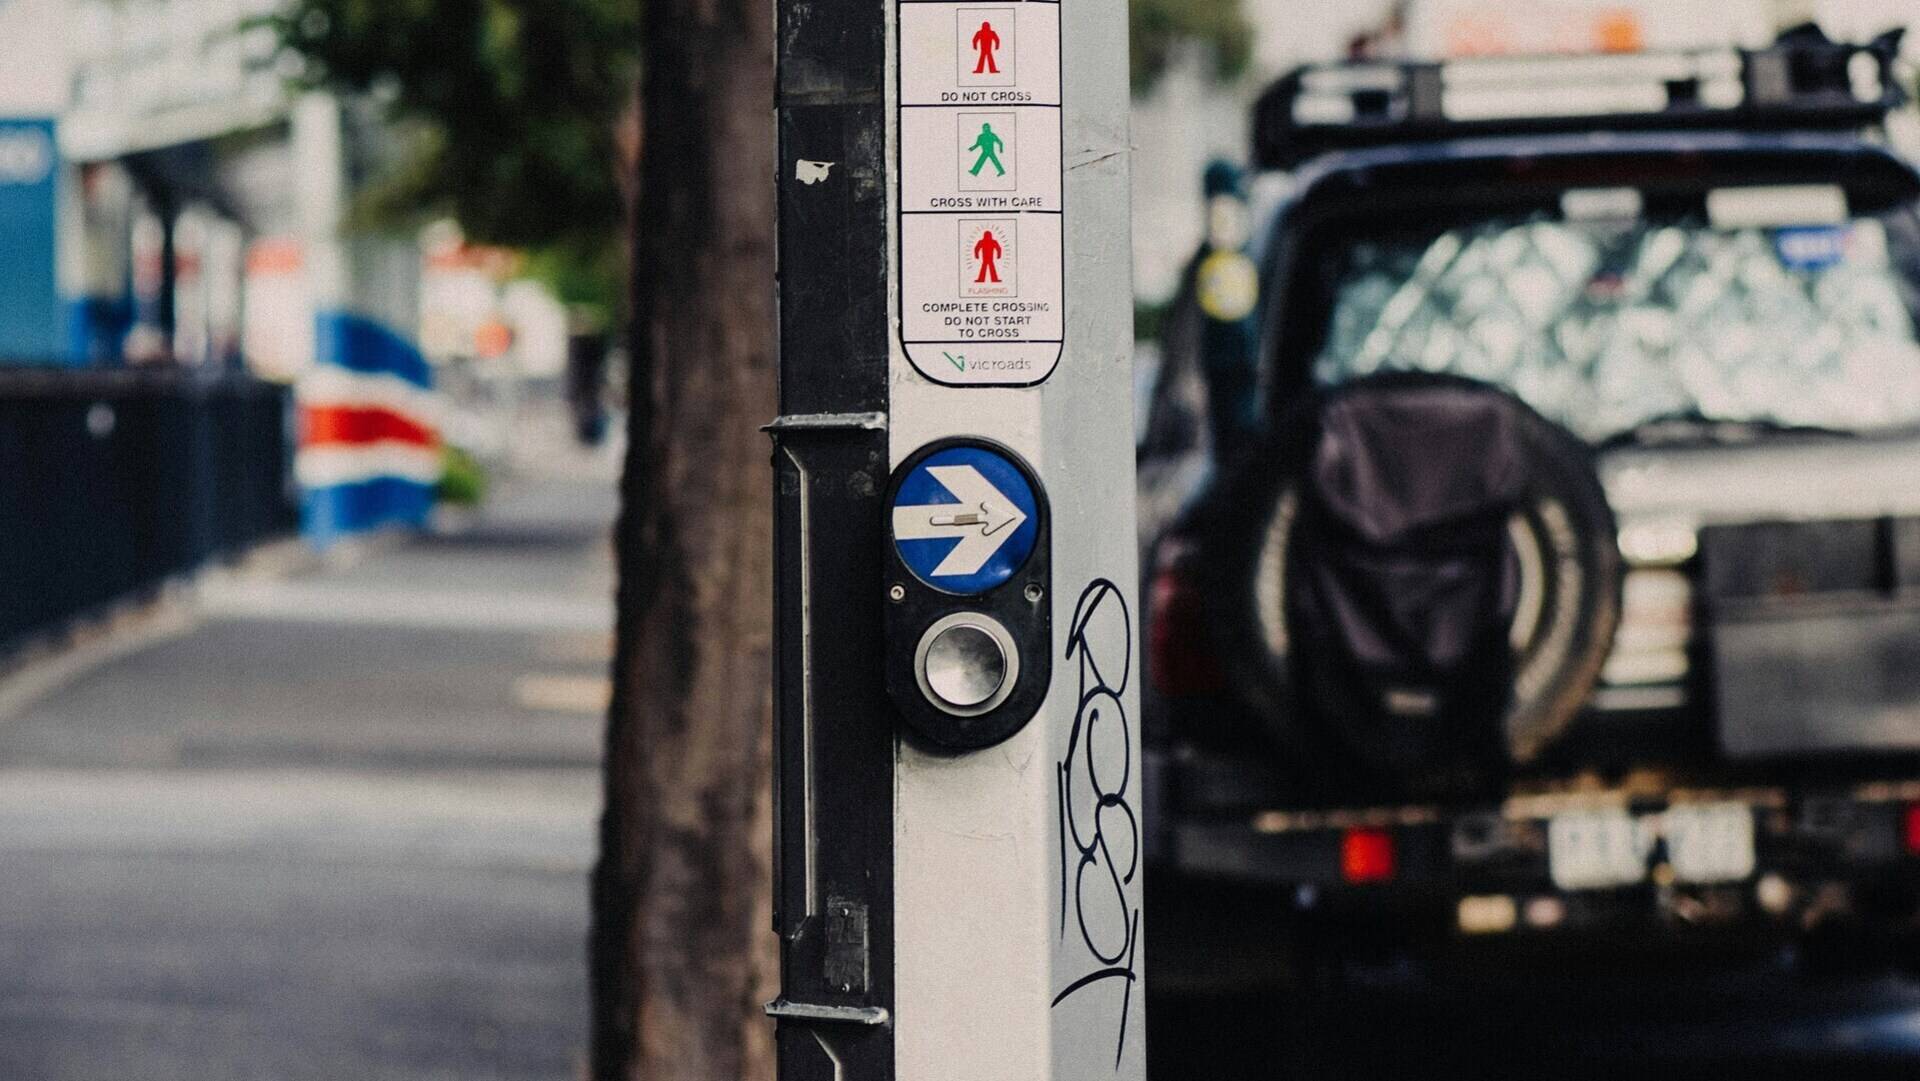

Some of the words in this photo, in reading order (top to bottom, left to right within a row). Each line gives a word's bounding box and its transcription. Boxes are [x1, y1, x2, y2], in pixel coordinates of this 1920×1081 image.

[941, 92, 958, 101] DO
[963, 92, 986, 101] NOT
[991, 91, 1032, 101] CROSS
[930, 198, 972, 208] CROSS
[976, 198, 1007, 207] WITH
[1012, 197, 1042, 207] CARE
[922, 303, 988, 313] COMPLETE
[992, 302, 1050, 312] CROSSING
[944, 316, 961, 326] DO
[965, 316, 990, 326] NOT
[994, 316, 1032, 326] START
[959, 328, 975, 338] TO
[978, 328, 1019, 338] CROSS
